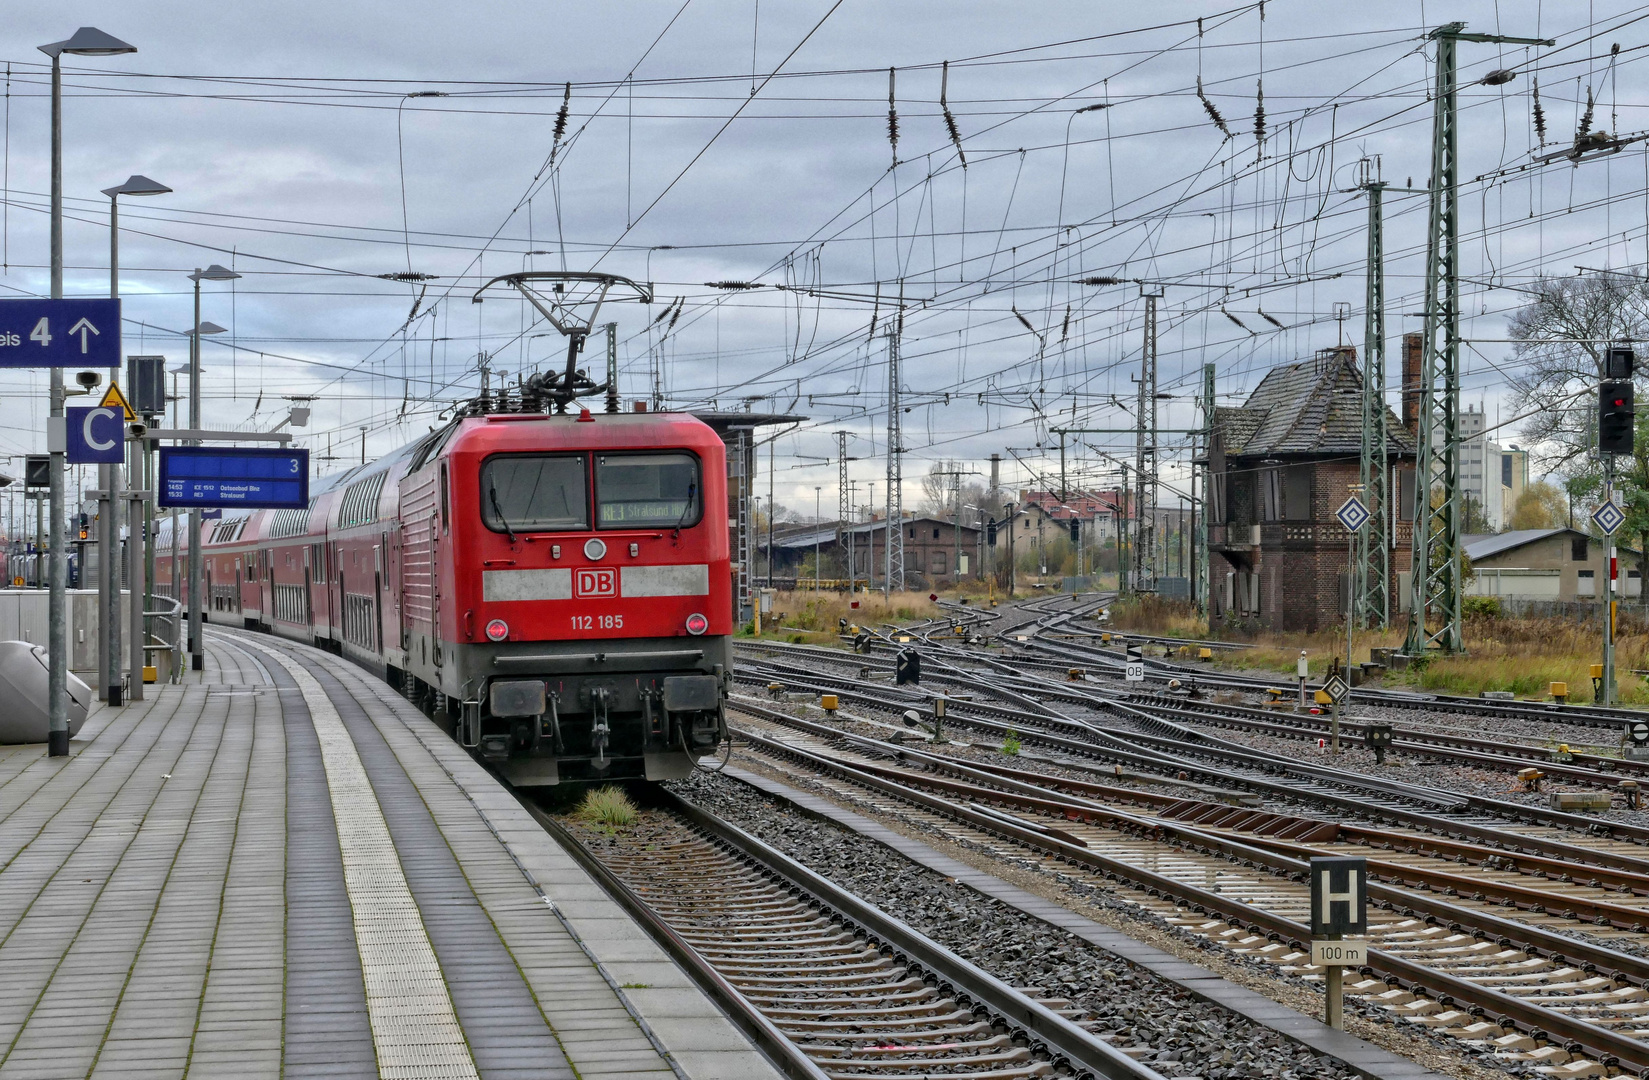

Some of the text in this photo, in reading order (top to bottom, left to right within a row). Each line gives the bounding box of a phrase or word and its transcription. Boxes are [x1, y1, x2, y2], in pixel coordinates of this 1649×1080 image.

[30, 316, 52, 346] 4
[83, 407, 116, 451] C
[290, 459, 299, 473] 3
[603, 503, 625, 521] RE3
[628, 504, 669, 517] Stralsund
[581, 573, 612, 593] DB
[571, 614, 624, 630] 112 185
[1321, 869, 1358, 924] H
[1320, 947, 1359, 960] 100 m
